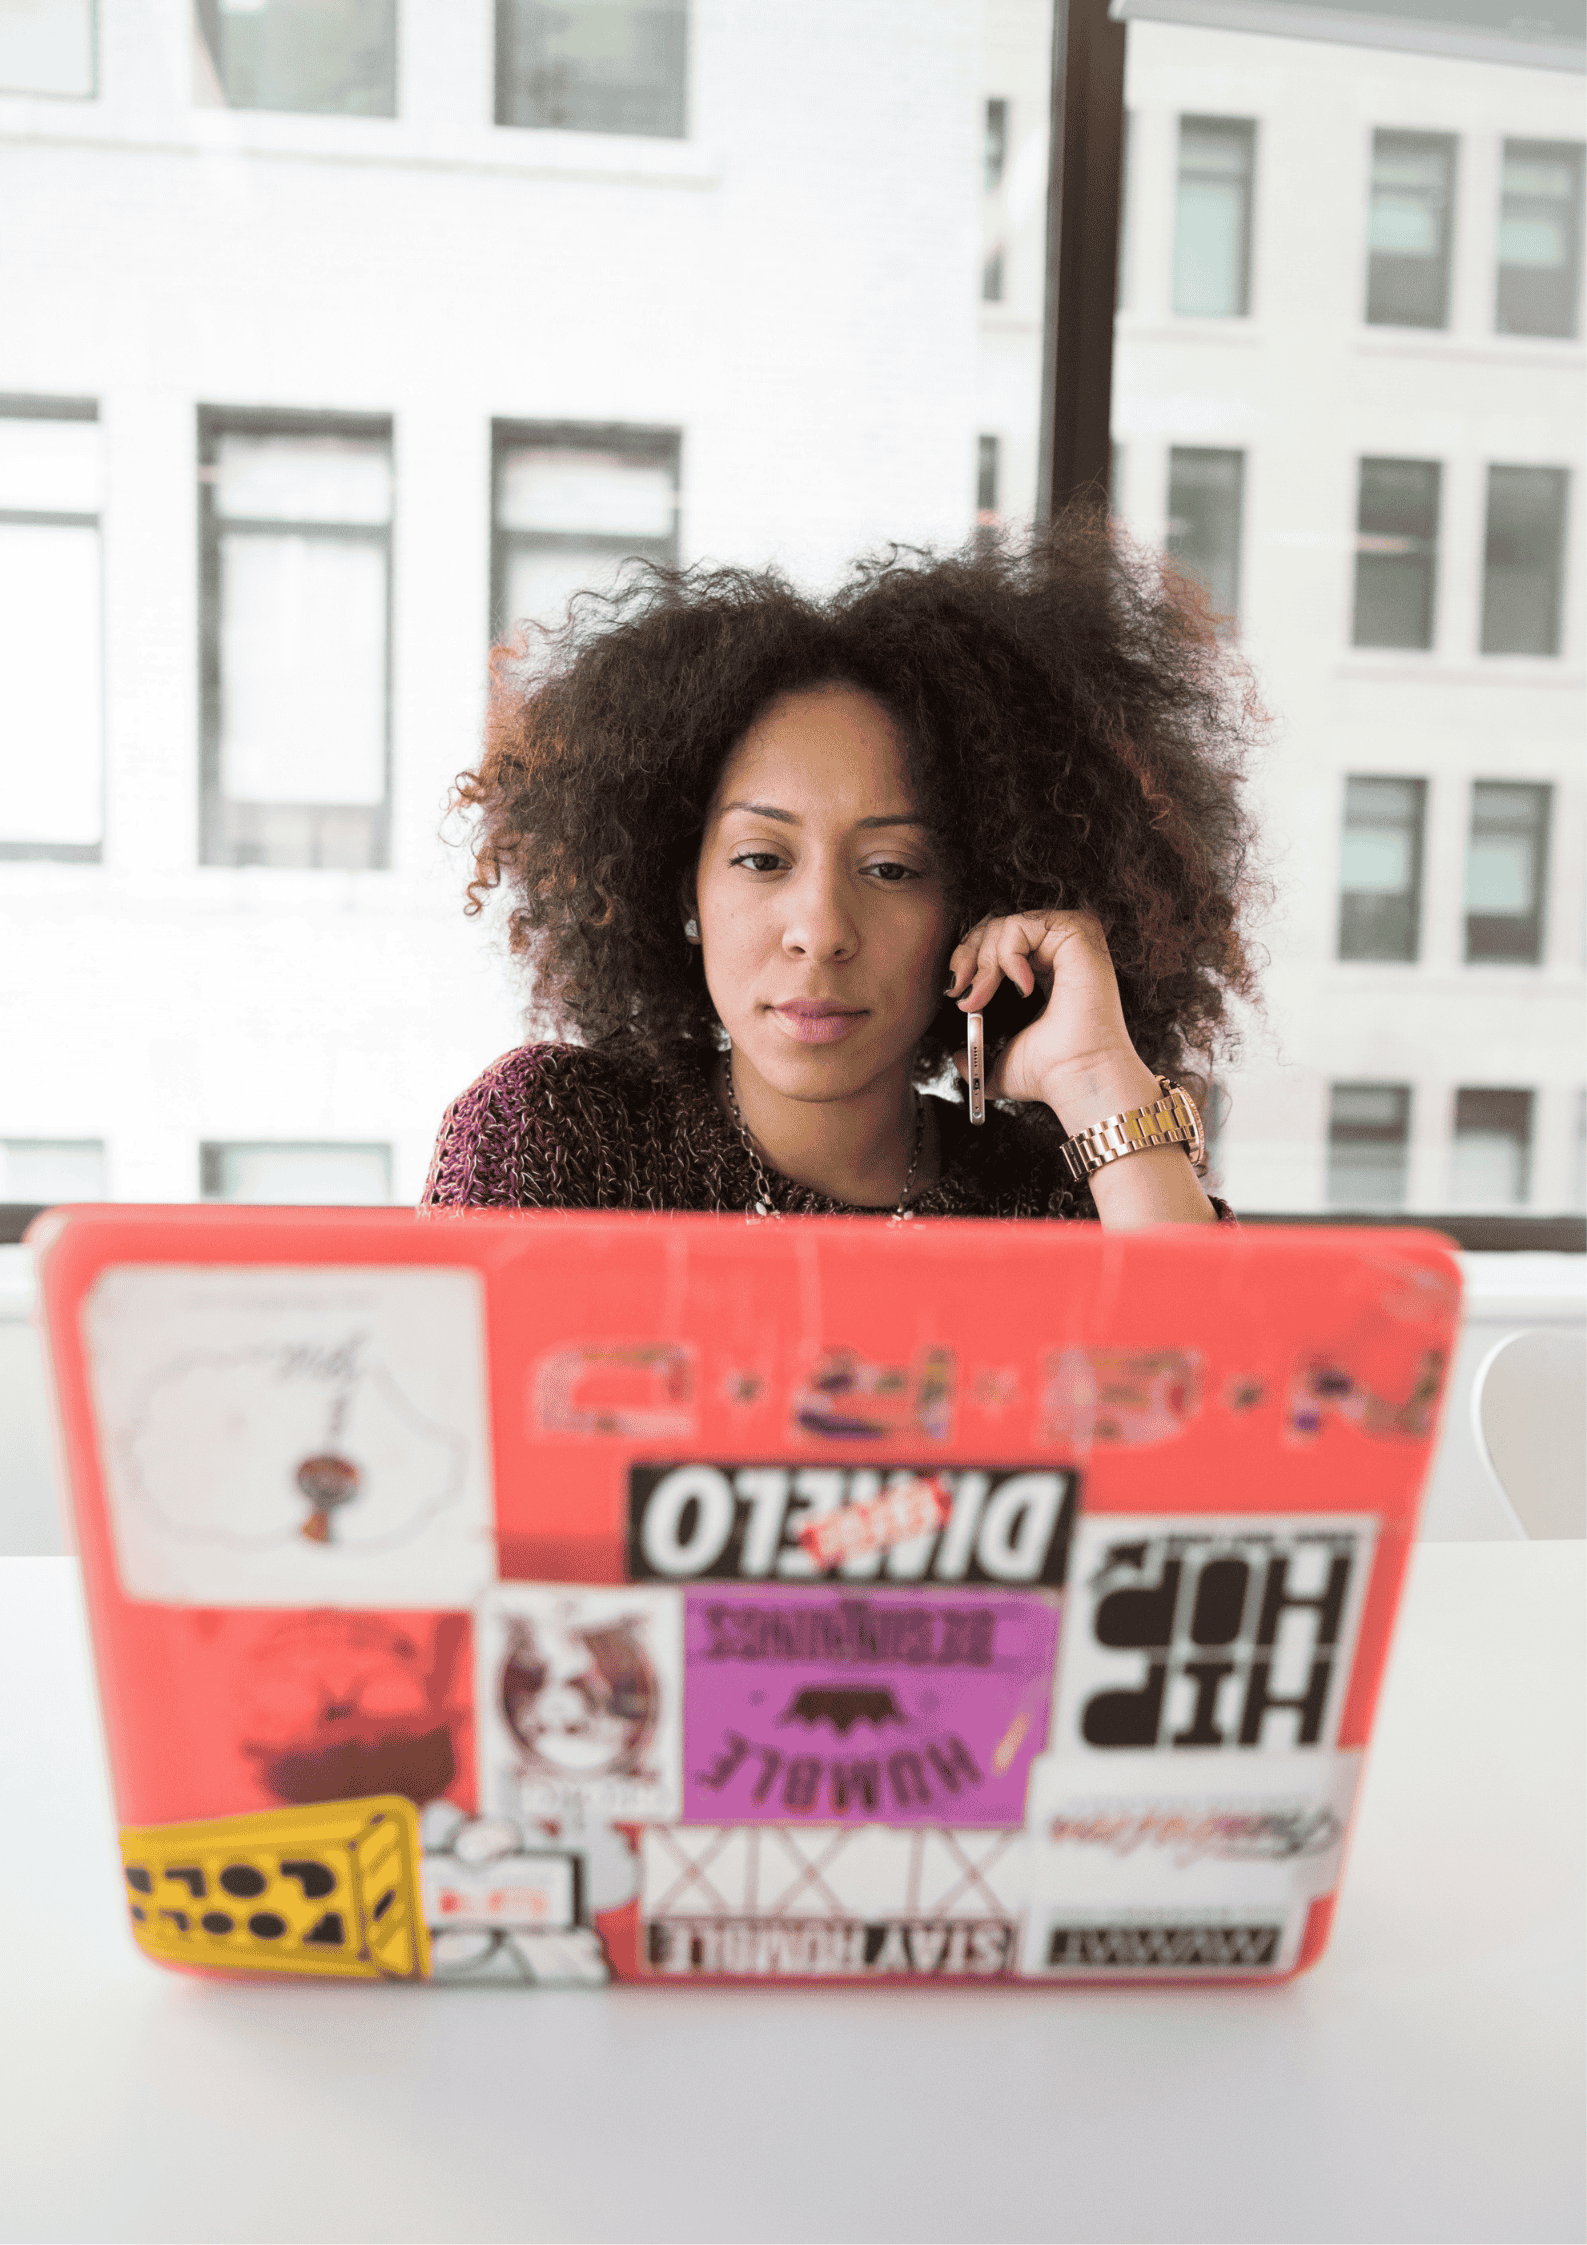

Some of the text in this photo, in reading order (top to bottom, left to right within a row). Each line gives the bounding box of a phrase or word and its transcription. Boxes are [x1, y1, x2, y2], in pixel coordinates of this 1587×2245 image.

[705, 1604, 995, 1666] BEGINNINGS
[1094, 1554, 1355, 1649] HOP
[1081, 1661, 1334, 1749] HIP
[696, 1728, 984, 1814] HUMBLE
[662, 1925, 1004, 1974] STAY HUMBLE
